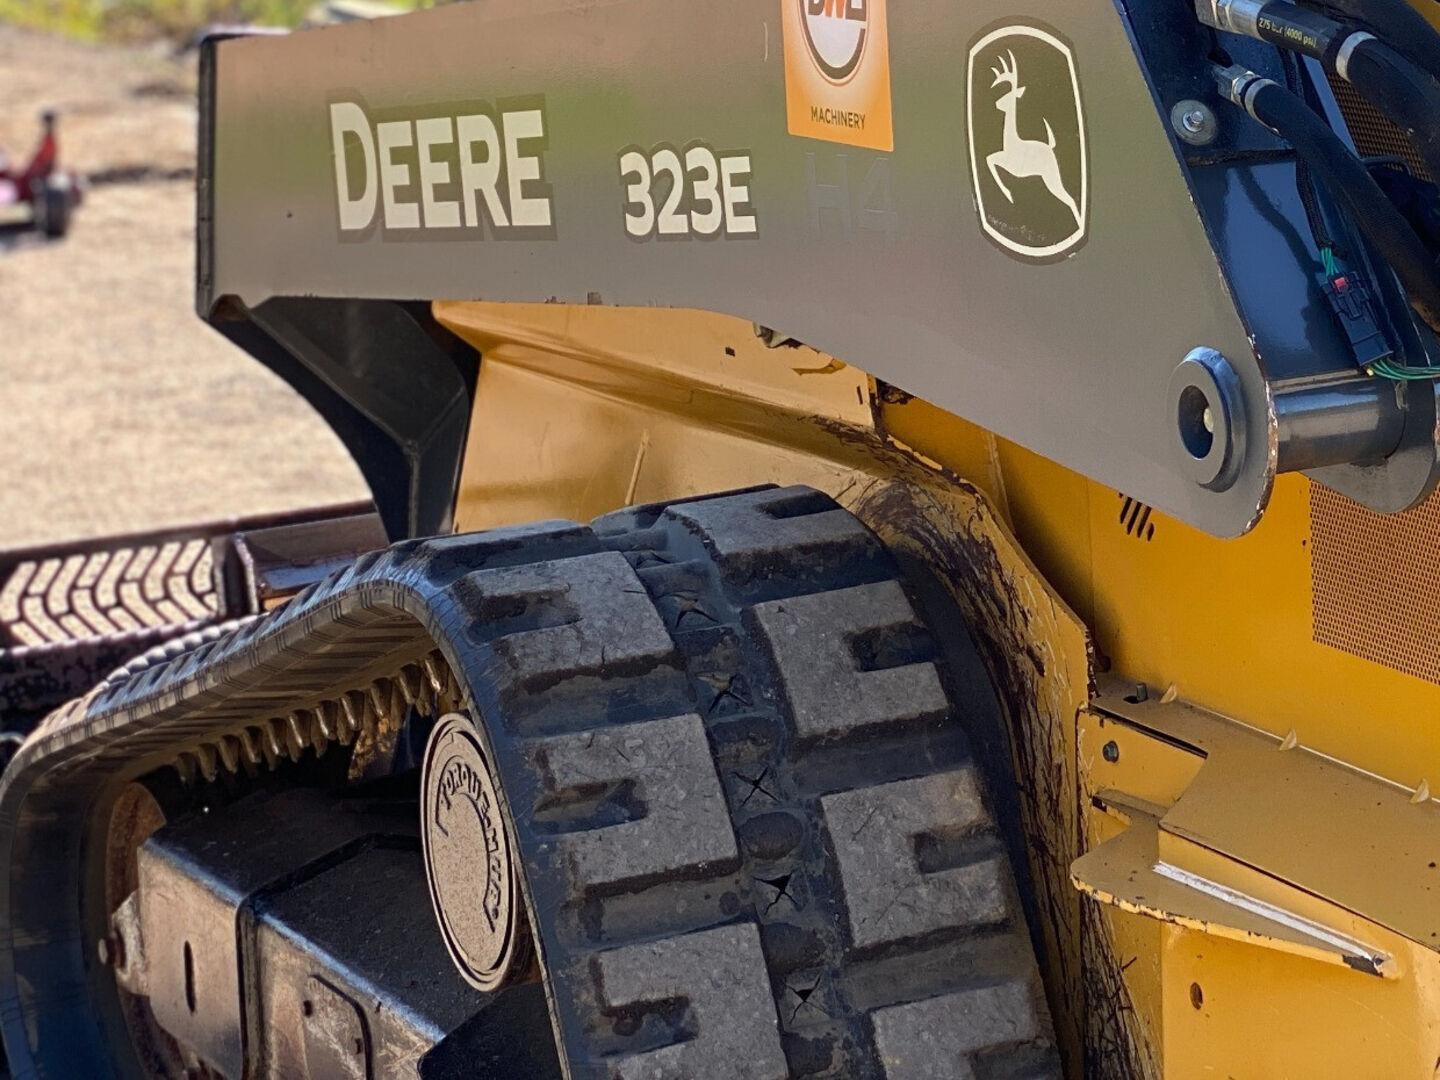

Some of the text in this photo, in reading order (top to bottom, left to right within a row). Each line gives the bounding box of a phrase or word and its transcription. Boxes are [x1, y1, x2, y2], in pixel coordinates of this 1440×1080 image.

[810, 106, 866, 130] MACHINERY
[330, 101, 757, 236] DEERE 323E
